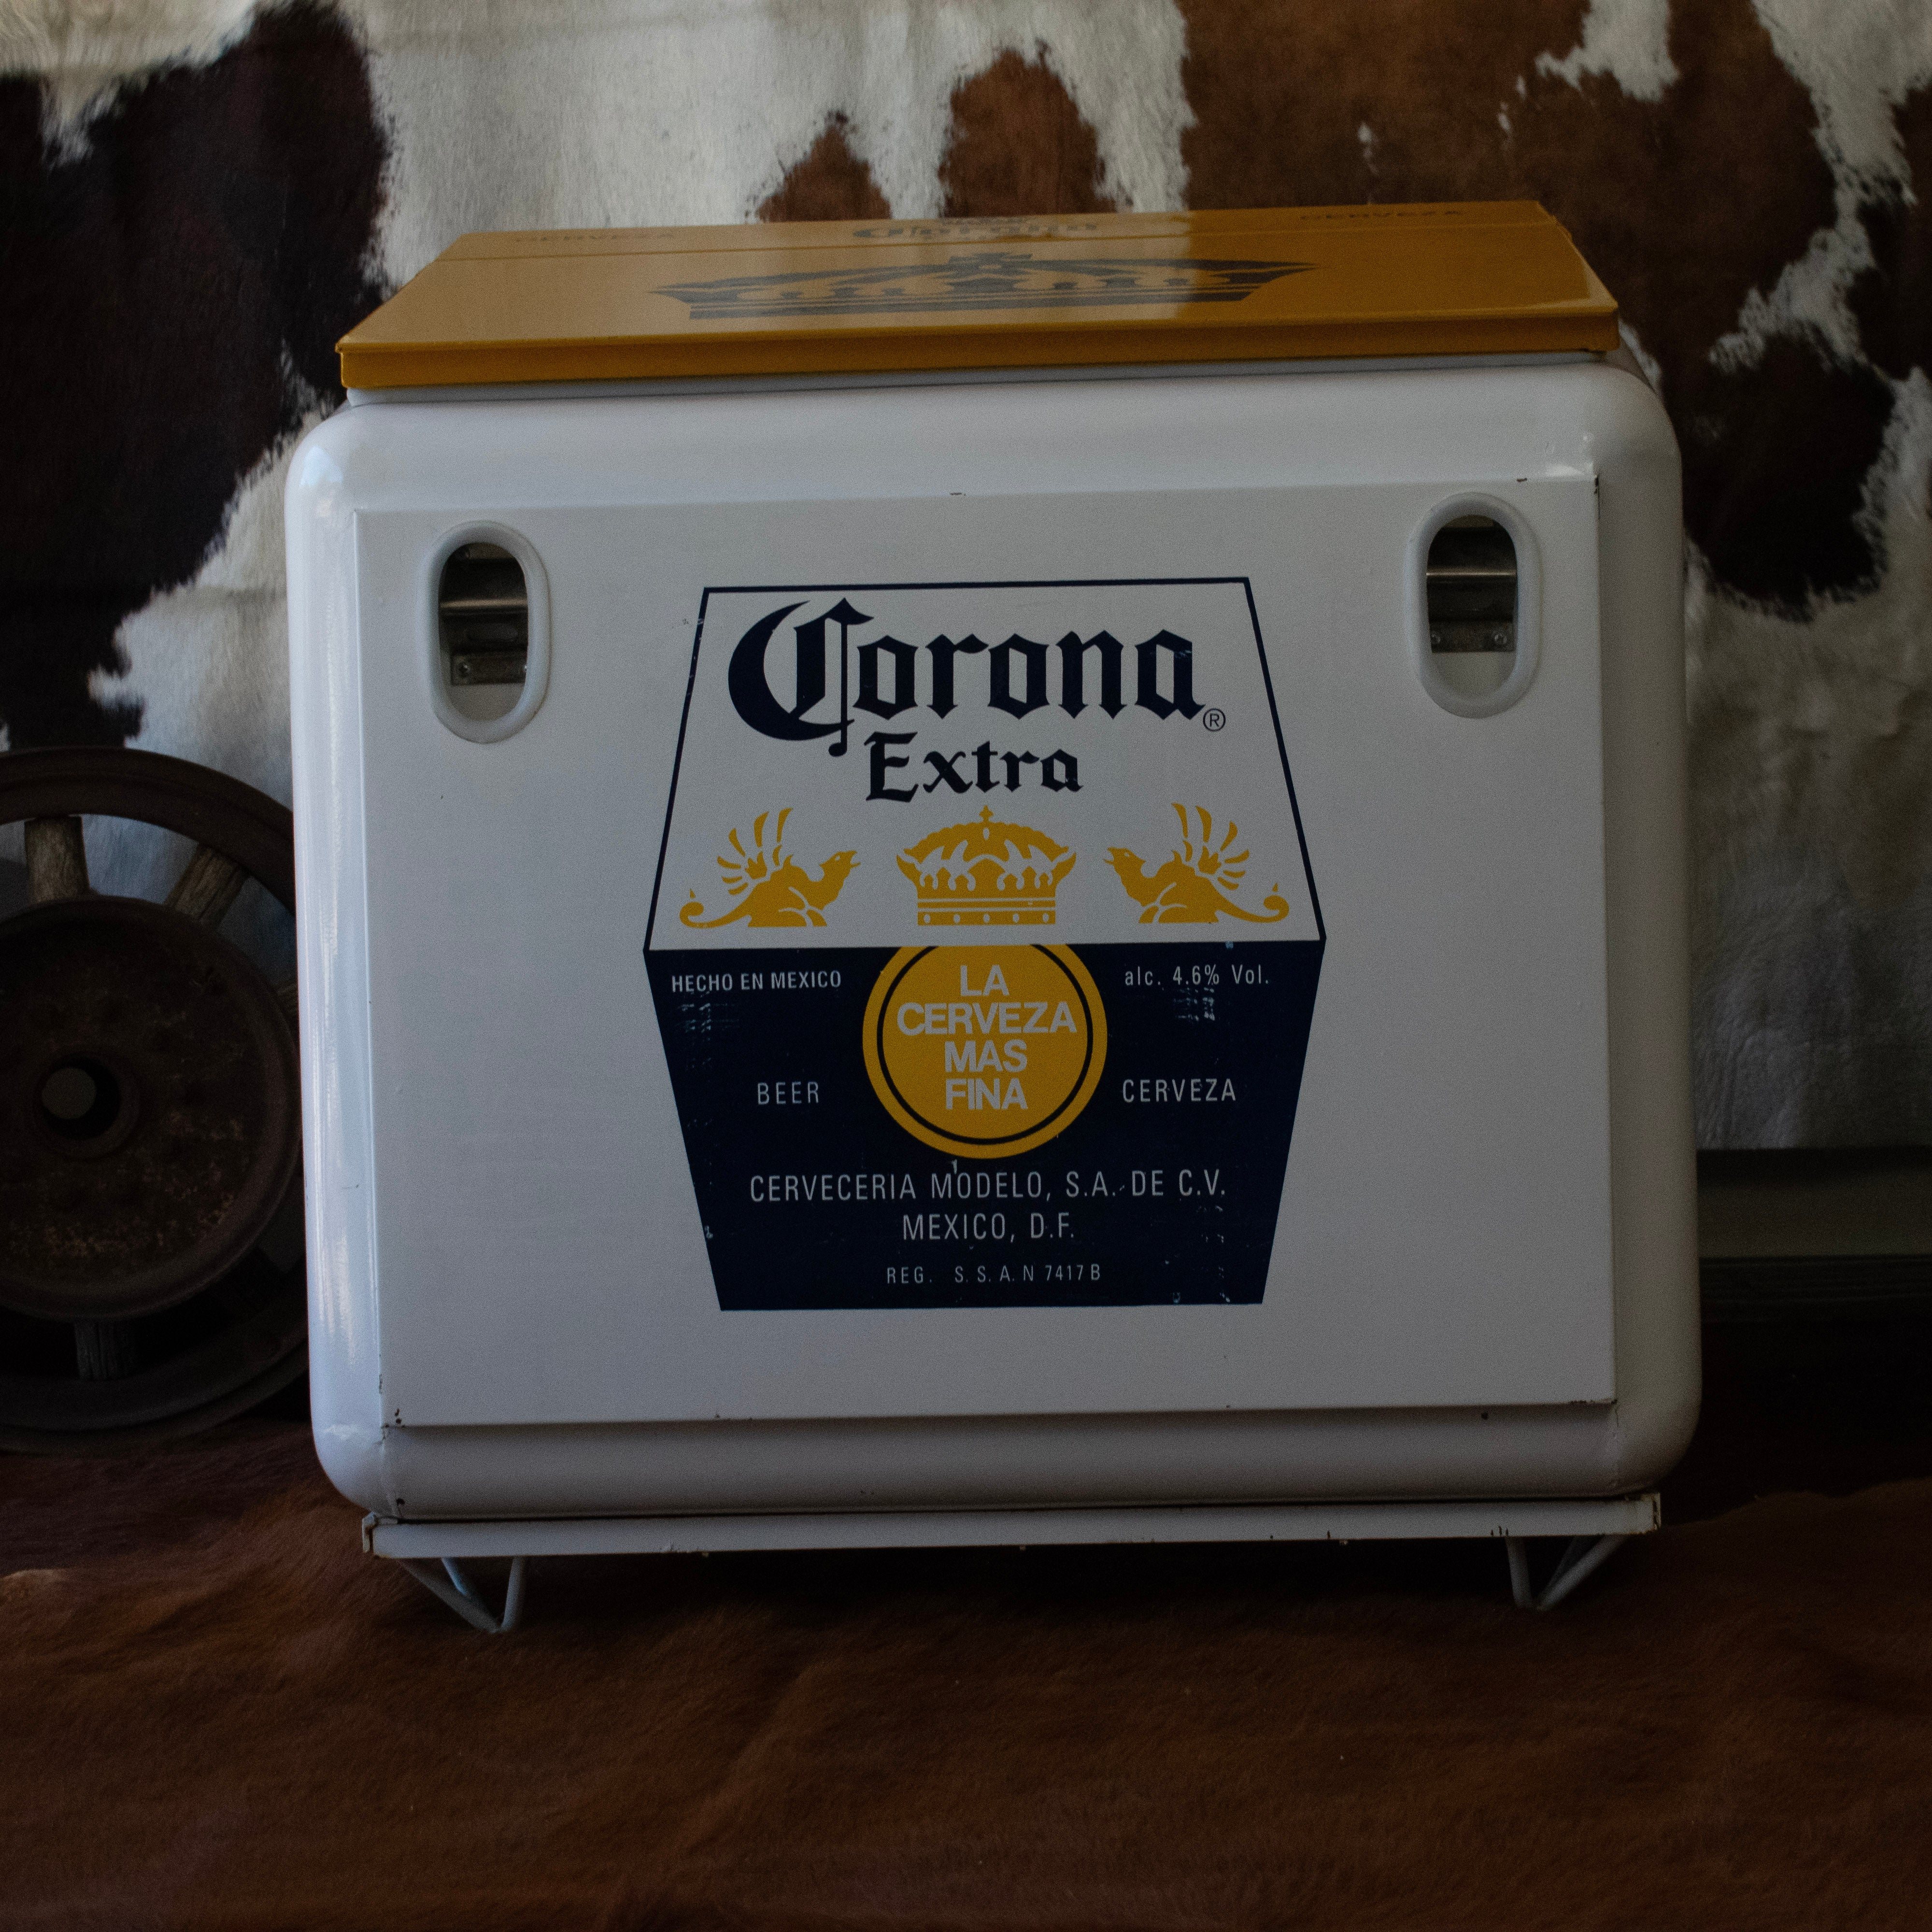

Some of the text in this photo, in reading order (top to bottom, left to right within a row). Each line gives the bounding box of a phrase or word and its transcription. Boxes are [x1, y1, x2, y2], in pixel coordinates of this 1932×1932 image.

[728, 598, 1206, 757] Corona
[864, 732, 1082, 802] Extra
[672, 971, 840, 992] HECHO EN MEXICO
[961, 965, 1009, 996] LA
[1125, 965, 1268, 985] alc. 4.6% Vol.
[897, 1002, 1077, 1035] CERVEZA
[945, 1039, 1027, 1072] MAS
[758, 1082, 818, 1104] BEER
[946, 1078, 1027, 1109] FINA
[1123, 1079, 1236, 1102] CERVEZA
[751, 1169, 1224, 1202] CERVECERIA MODELO, S.A. DE C.V.
[903, 1213, 1073, 1242] MEXICO, D.F.
[887, 1266, 933, 1283] REG.
